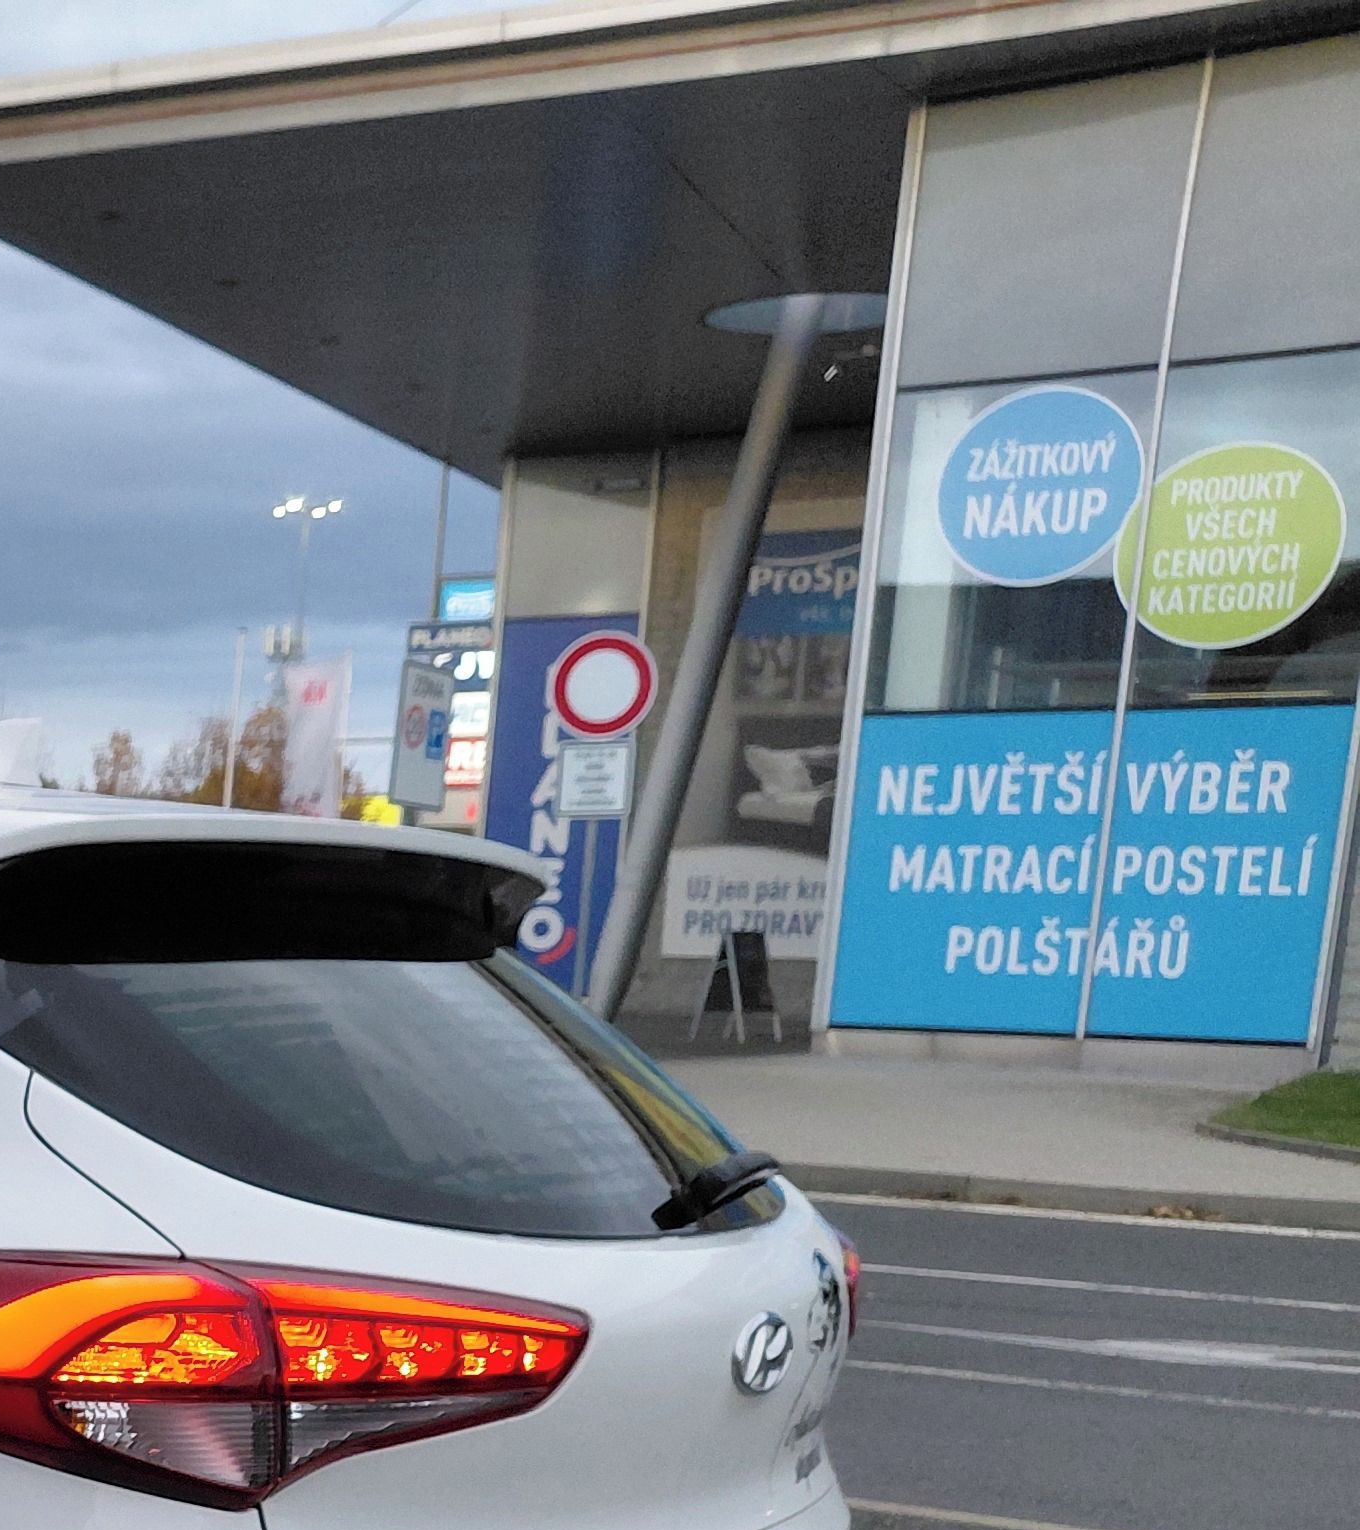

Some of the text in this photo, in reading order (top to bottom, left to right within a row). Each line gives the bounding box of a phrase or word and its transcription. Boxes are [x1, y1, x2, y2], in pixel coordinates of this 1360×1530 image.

[967, 430, 1117, 482] ZÁŽITKOVÝ
[962, 483, 1108, 539] NÁKUP
[1170, 469, 1304, 506] PRODUKTY
[1185, 502, 1277, 541] VŠECH
[1152, 535, 1301, 580] CENOVÝCH
[1146, 573, 1298, 616] KATEGORIÍ
[878, 748, 1292, 816] NEJVĚTŠÍ VÝBĚR
[888, 834, 1320, 897] MATRACÍ POSTELÍ
[944, 914, 1191, 980] POLŠTÁŘŮ
